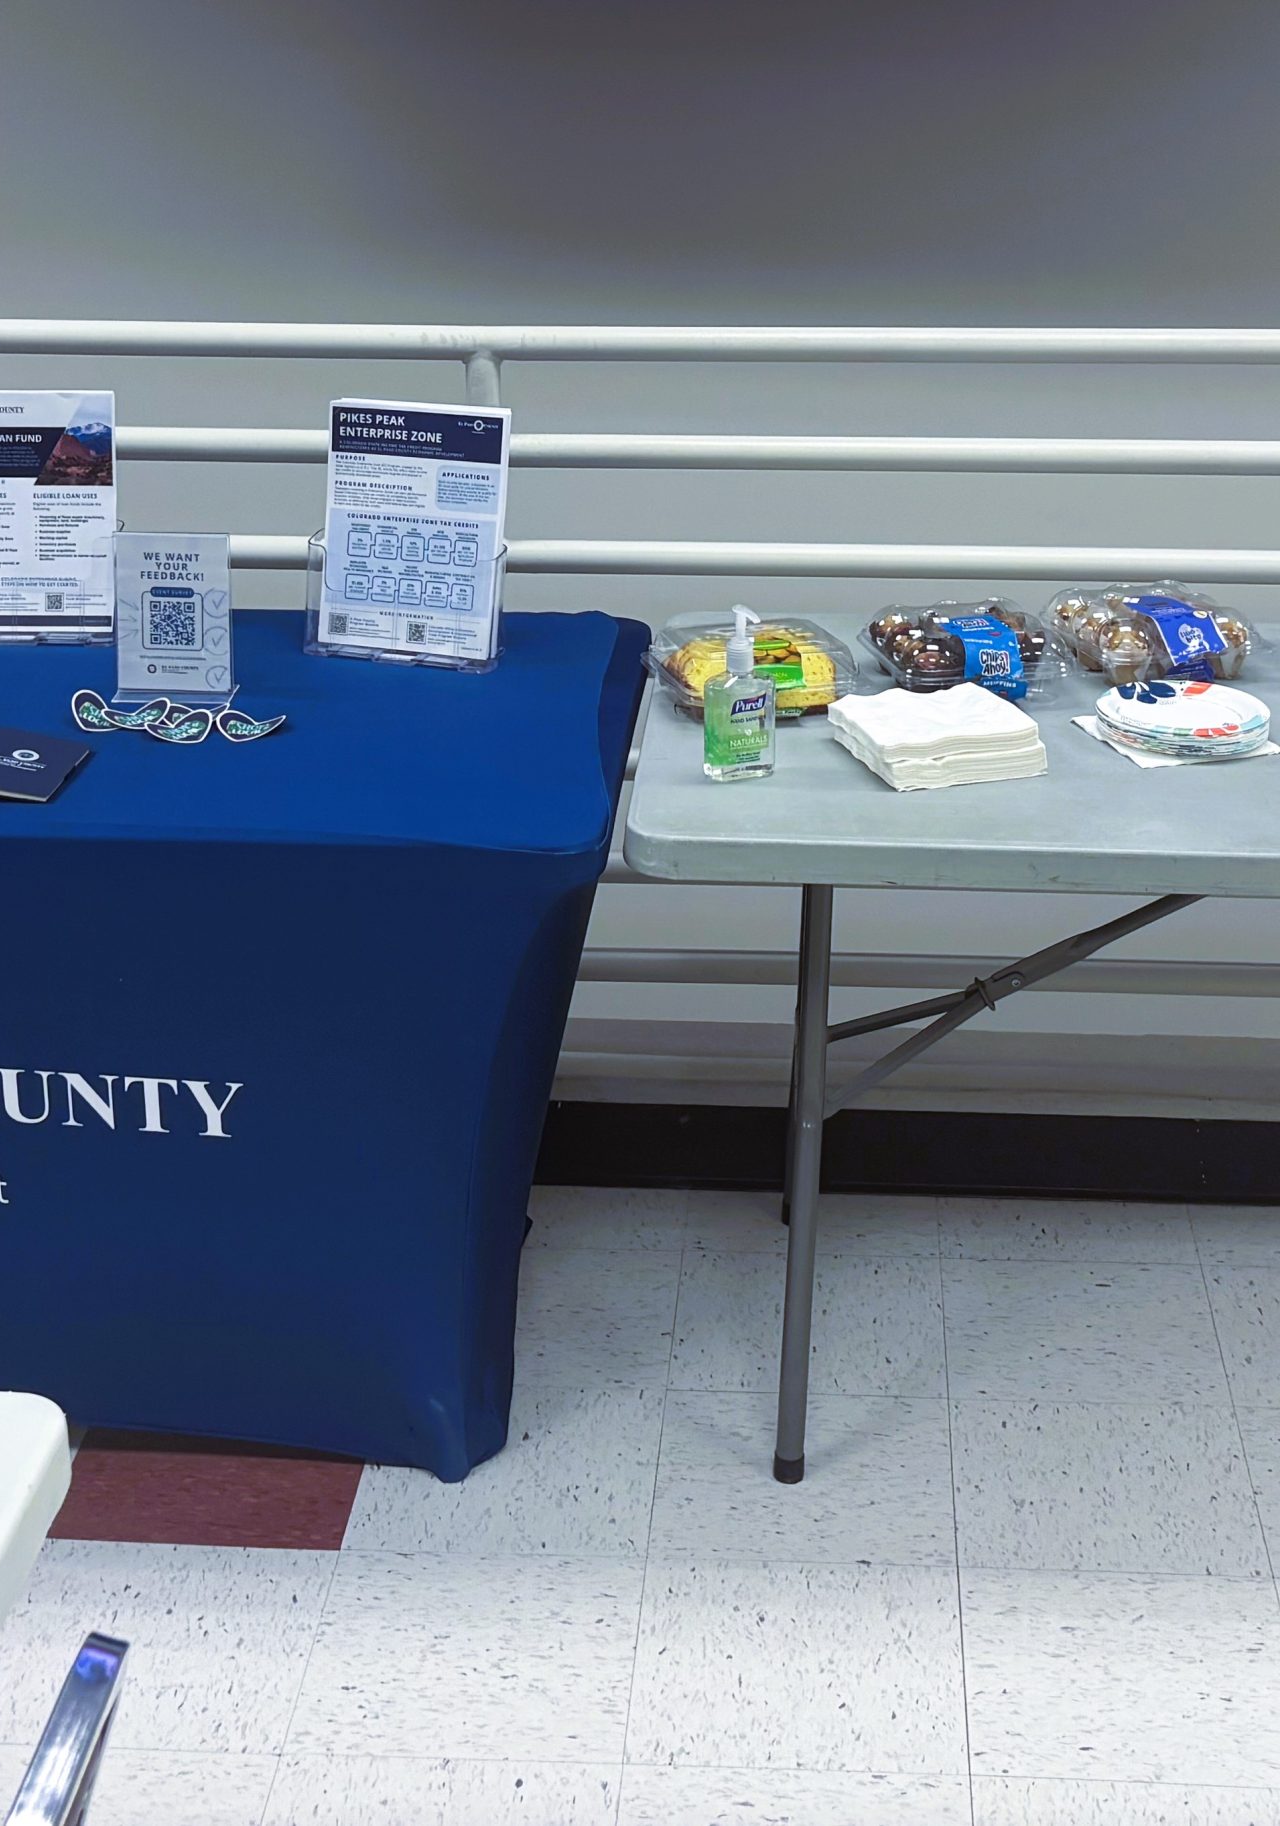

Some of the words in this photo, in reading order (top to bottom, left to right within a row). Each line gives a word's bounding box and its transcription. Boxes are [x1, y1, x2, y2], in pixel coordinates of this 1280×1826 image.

[339, 412, 373, 424] PIKES
[375, 415, 406, 426] PEAK
[15, 434, 43, 443] FUND
[339, 426, 408, 440] ENTERPRISE
[410, 431, 443, 443] ZONE
[335, 454, 366, 462] PURPOSE
[442, 472, 490, 481] APPLICATIONS
[335, 480, 367, 488] PROGRAM
[369, 482, 413, 491] DESCRIPTION
[347, 512, 381, 521] COLORADO
[383, 515, 419, 524] ENTERPRISE
[421, 518, 438, 526] ZONE
[453, 521, 480, 529] CREDITS
[143, 552, 161, 561] WE
[165, 553, 200, 562] WANT
[155, 562, 188, 571] YOUR
[140, 571, 204, 582] FEEDBACK!
[980, 650, 1005, 665] Chips
[735, 698, 763, 713] Purell
[729, 735, 768, 748] NATURALS
